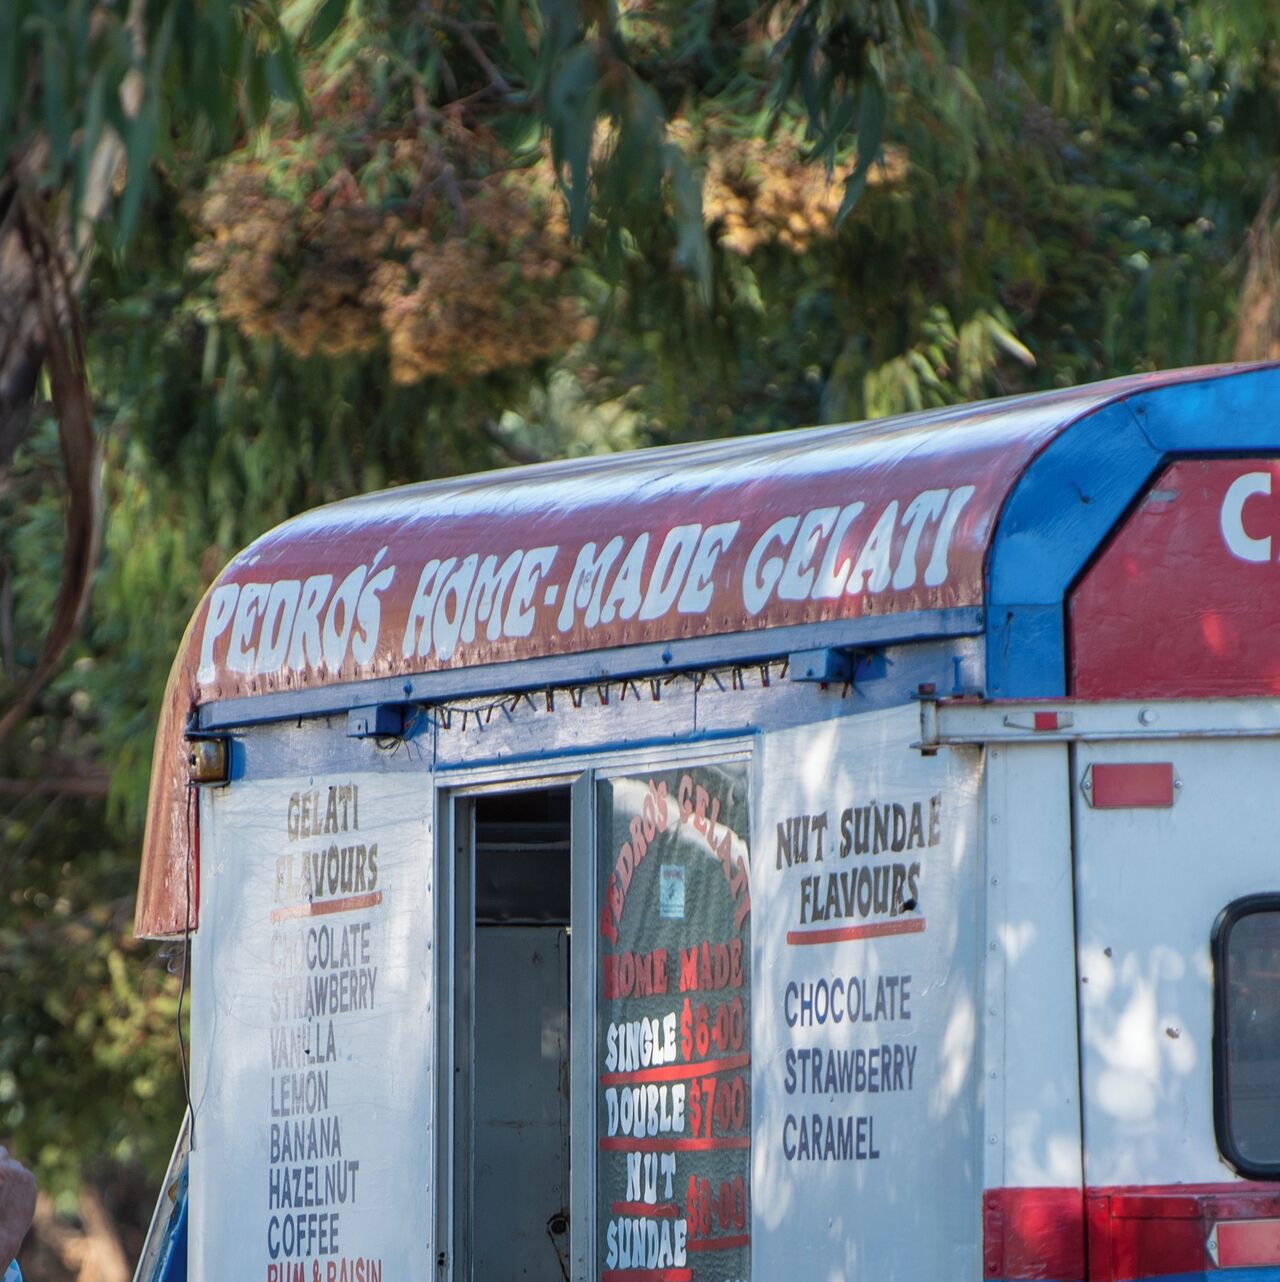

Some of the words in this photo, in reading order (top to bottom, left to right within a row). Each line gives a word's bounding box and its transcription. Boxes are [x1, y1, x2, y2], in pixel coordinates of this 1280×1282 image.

[198, 545, 396, 685] PEDRO'S
[403, 520, 740, 661] HOME-MADE
[745, 486, 975, 616] GELATI
[287, 784, 358, 842] GELATI
[776, 811, 827, 870] NUT
[840, 791, 942, 858] SUNDAE
[274, 843, 378, 903] FLAVOURS
[600, 778, 668, 945] PEDRO'S
[678, 774, 750, 931] GELATI
[799, 862, 921, 924] FLAVOURS
[270, 922, 370, 975] CHOCOLATE
[604, 947, 668, 1000] HOME
[679, 938, 743, 992] MADE
[270, 967, 378, 1022] STRAWBERRY
[784, 975, 912, 1028] CHOCOLATE
[605, 1011, 677, 1073] SINGLE
[271, 1070, 328, 1117] LEMON
[784, 1044, 917, 1095] STRAWBERRY
[605, 1083, 686, 1138] DOUBLE
[782, 1113, 880, 1161] CARAMEL
[270, 1115, 341, 1163] BANANA
[269, 1160, 359, 1210] HAZELNUT
[626, 1152, 676, 1204] NUT
[267, 1213, 339, 1259] COFFEE
[605, 1217, 687, 1270] SUNDAE
